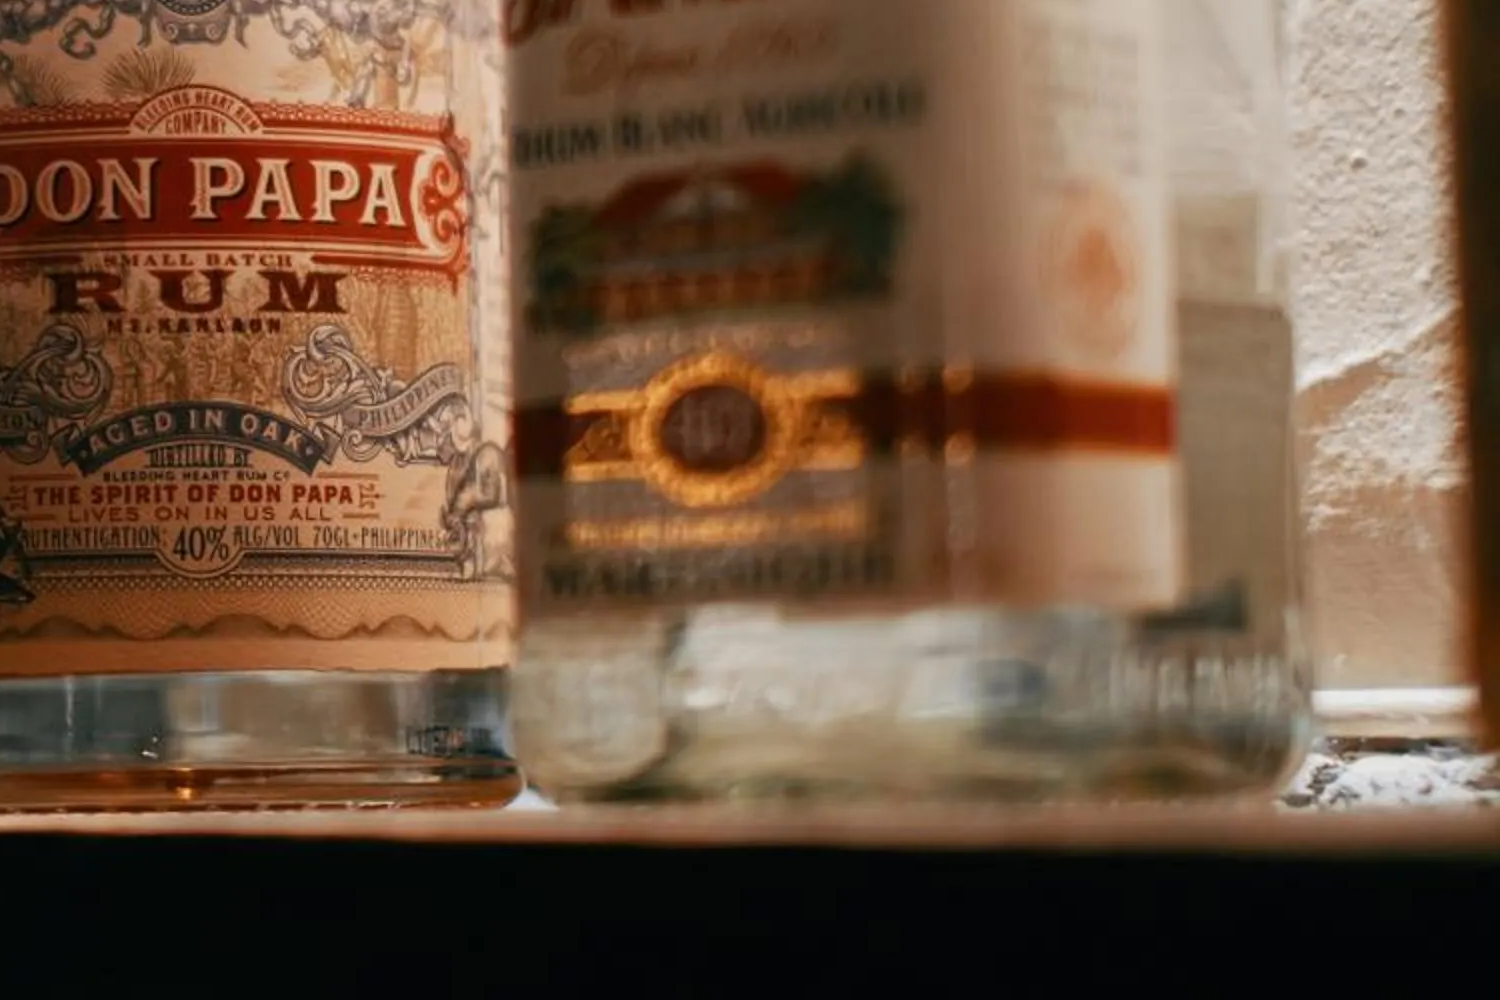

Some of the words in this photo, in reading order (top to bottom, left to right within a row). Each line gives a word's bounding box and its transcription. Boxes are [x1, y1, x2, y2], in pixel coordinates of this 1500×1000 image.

[164, 111, 227, 135] COMPANY
[190, 158, 407, 228] PAPA
[103, 253, 195, 268] SMALL
[205, 252, 294, 268] BATCH
[45, 269, 349, 314] RUM
[88, 410, 173, 453] AGED
[188, 409, 224, 429] IN
[240, 413, 301, 451] OAK
[103, 471, 177, 483] BLEEDING
[182, 470, 230, 482] HEART
[236, 470, 267, 482] RUM
[33, 486, 82, 506] THE
[90, 484, 178, 506] SPIRIT
[187, 483, 218, 503] OF
[228, 483, 282, 503] DON
[291, 484, 354, 505] PAPA
[67, 506, 141, 524] LIVES
[153, 505, 190, 522] ON
[204, 505, 229, 521] IN
[243, 505, 276, 522] US
[288, 506, 333, 522] ALL
[172, 524, 230, 563] 40%
